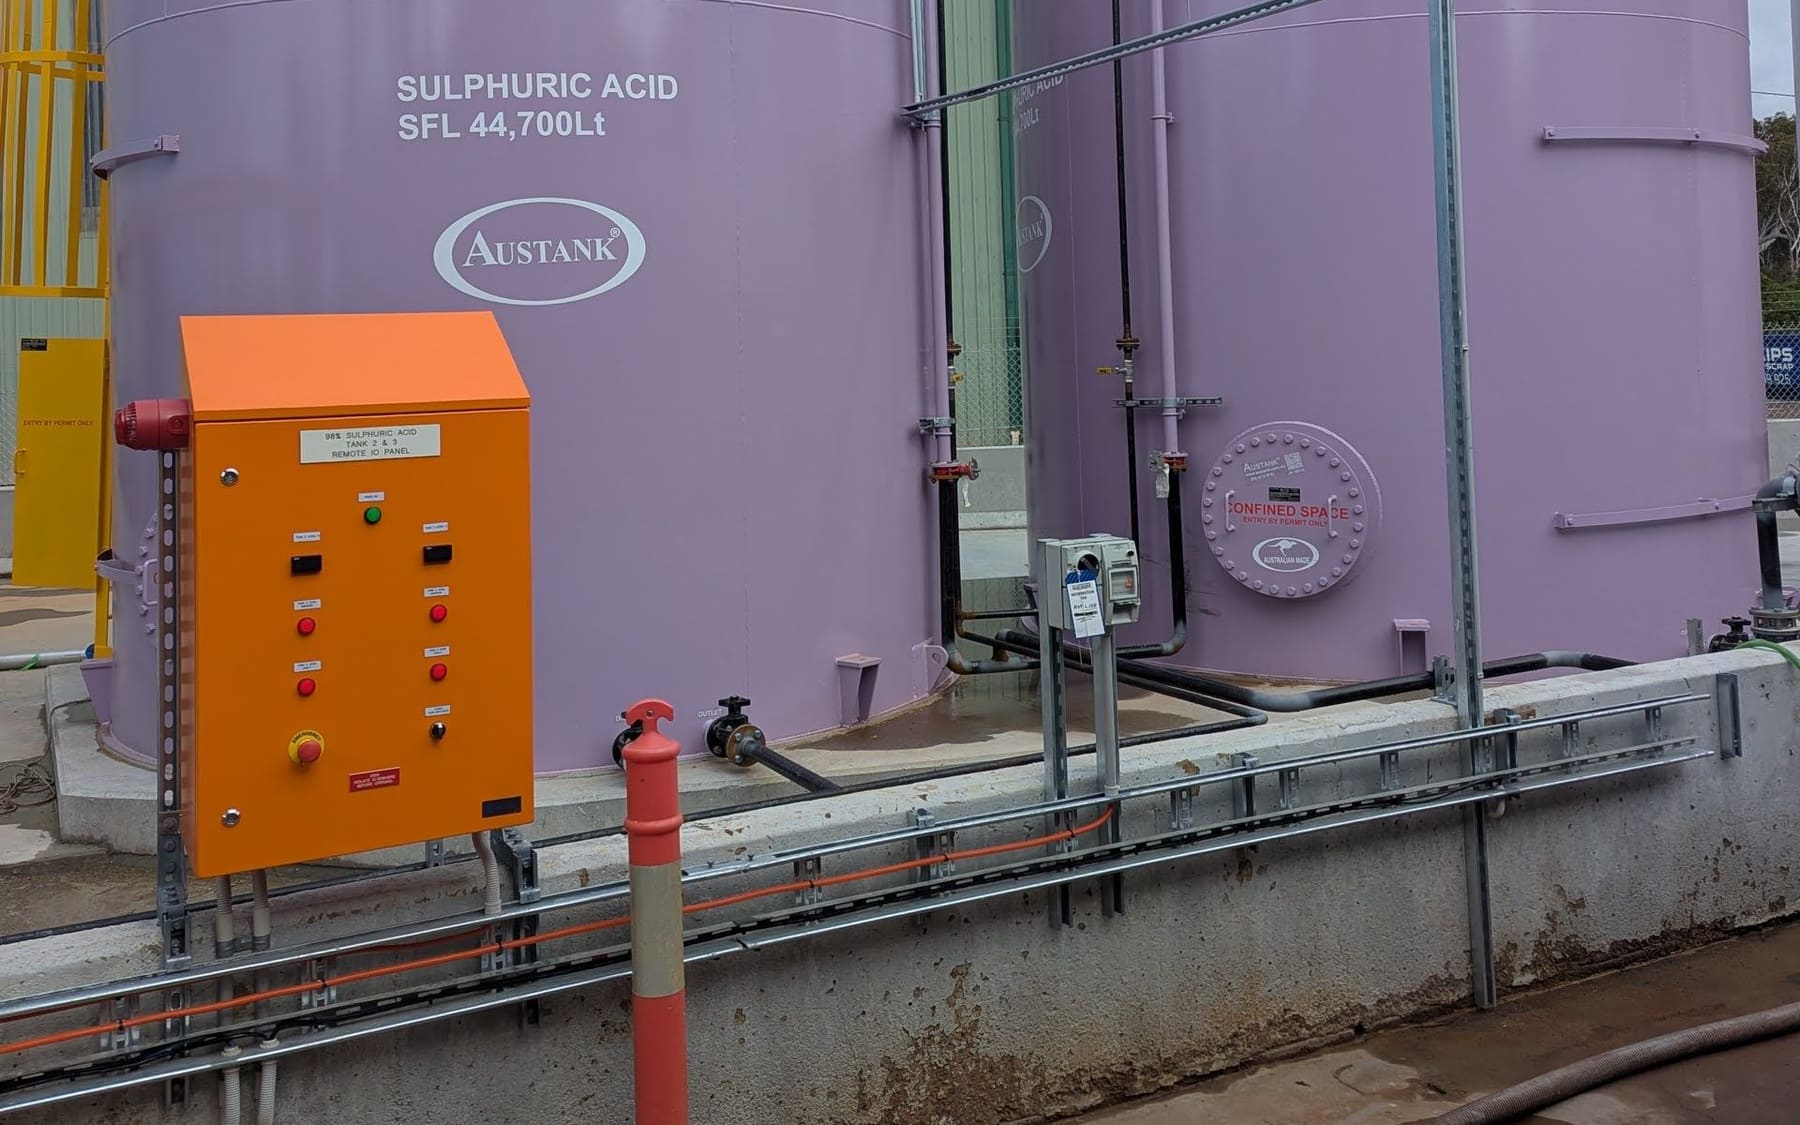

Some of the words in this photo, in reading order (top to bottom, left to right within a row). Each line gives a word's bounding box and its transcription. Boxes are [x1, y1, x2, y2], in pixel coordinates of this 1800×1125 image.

[397, 72, 592, 102] SULPHURIC
[600, 73, 678, 100] ACID
[398, 112, 461, 140] SFL
[469, 110, 606, 141] 44,700Lt
[1764, 347, 1793, 362] IPS
[1765, 363, 1793, 371] SCRAP
[346, 430, 393, 439] SULPHURIC
[397, 428, 417, 436] ACID
[345, 440, 368, 448] TANK
[332, 450, 366, 458] REMOTE
[1226, 502, 1296, 517] CONFINED
[1300, 505, 1349, 519] SPACE
[1243, 516, 1266, 524] ENTRY
[1268, 517, 1278, 525] BY
[1280, 518, 1306, 526] PERMIT
[1308, 520, 1328, 528] ONLY
[698, 708, 723, 718] OUTLET
